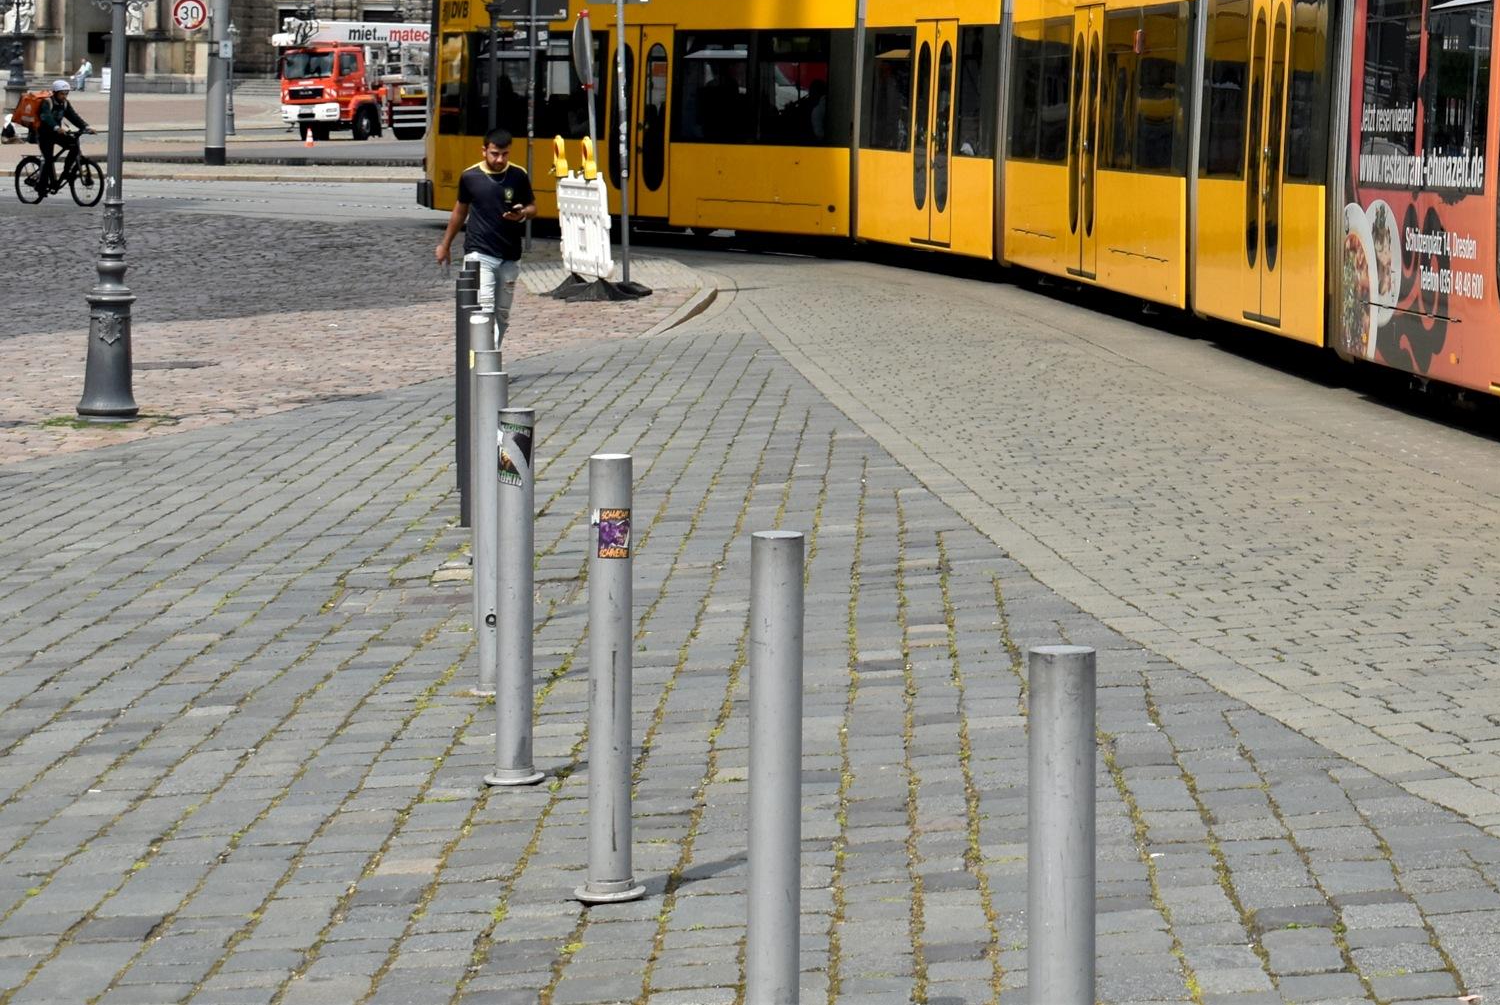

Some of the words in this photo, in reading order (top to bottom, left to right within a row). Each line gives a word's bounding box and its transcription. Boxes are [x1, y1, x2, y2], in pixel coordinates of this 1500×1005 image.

[180, 6, 199, 20] 30
[450, 0, 469, 19] DVB
[348, 25, 388, 41] miet...
[1361, 101, 1376, 132] Jetzt
[1376, 101, 1415, 132] reservieren!
[1360, 147, 1484, 188] www.restaurant-chinazeit.de
[1405, 227, 1442, 259] Schützenplatz
[1453, 232, 1477, 260] Dresden
[1420, 265, 1439, 292] Telefon
[1440, 268, 1453, 294] 0351
